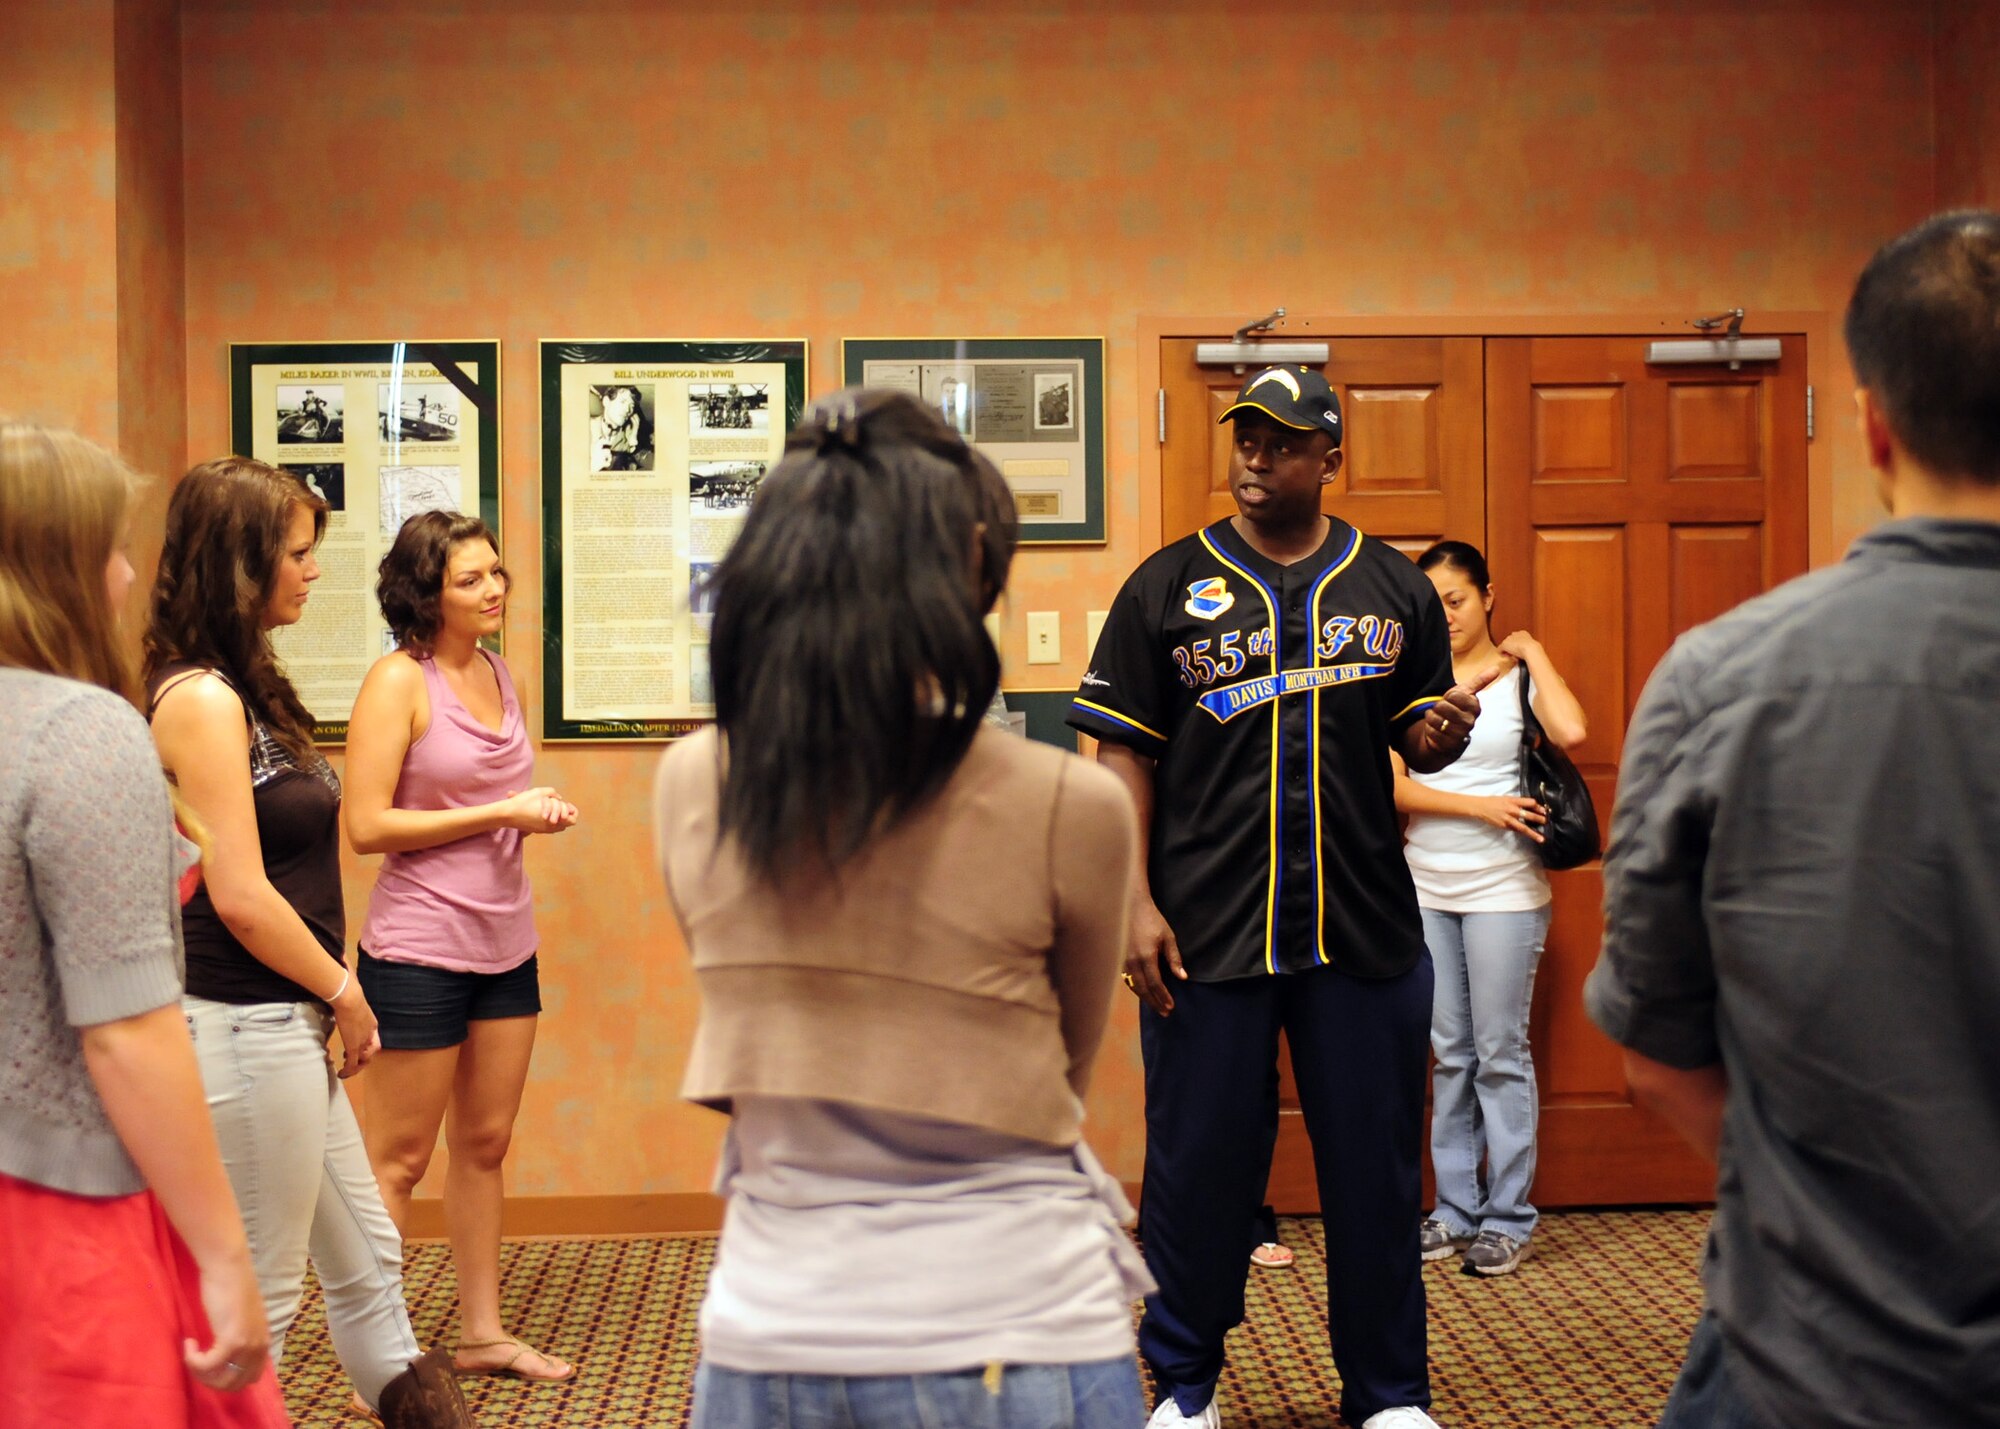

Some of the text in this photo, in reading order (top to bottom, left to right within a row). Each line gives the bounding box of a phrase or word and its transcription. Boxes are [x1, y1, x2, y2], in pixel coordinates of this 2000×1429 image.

[280, 370, 308, 379] MILES
[310, 370, 339, 379] BAKER
[342, 370, 351, 379] IN
[614, 370, 734, 379] BILL UNDERWOOD IN WWII
[438, 412, 458, 426] 50
[1228, 666, 1361, 709] DAVIS MONTHAN AFB
